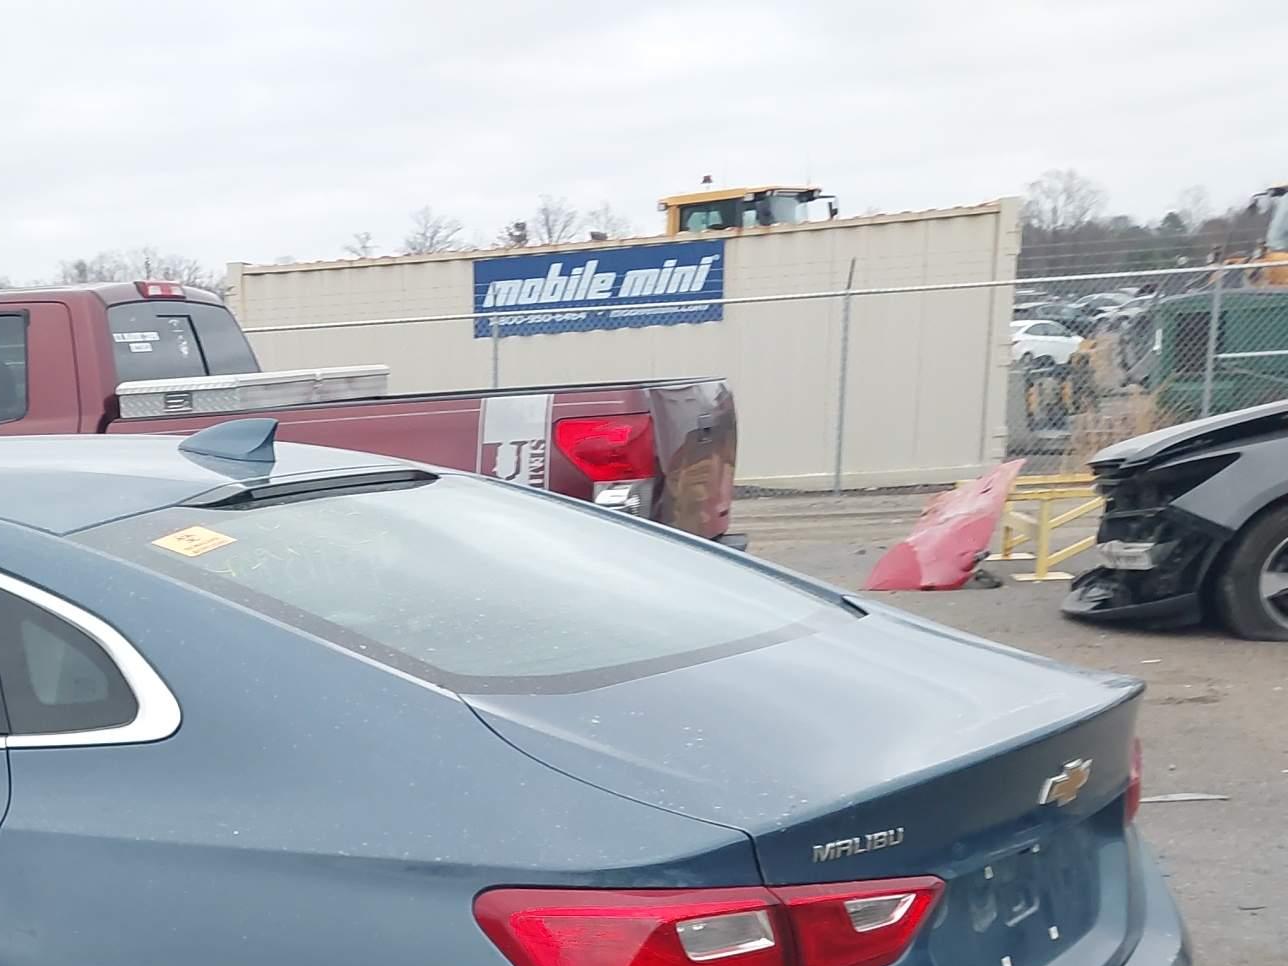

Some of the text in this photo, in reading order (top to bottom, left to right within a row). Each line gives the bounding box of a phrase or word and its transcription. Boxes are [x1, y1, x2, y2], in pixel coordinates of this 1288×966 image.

[483, 255, 715, 308] mobile mini
[813, 827, 904, 863] MALIBU
